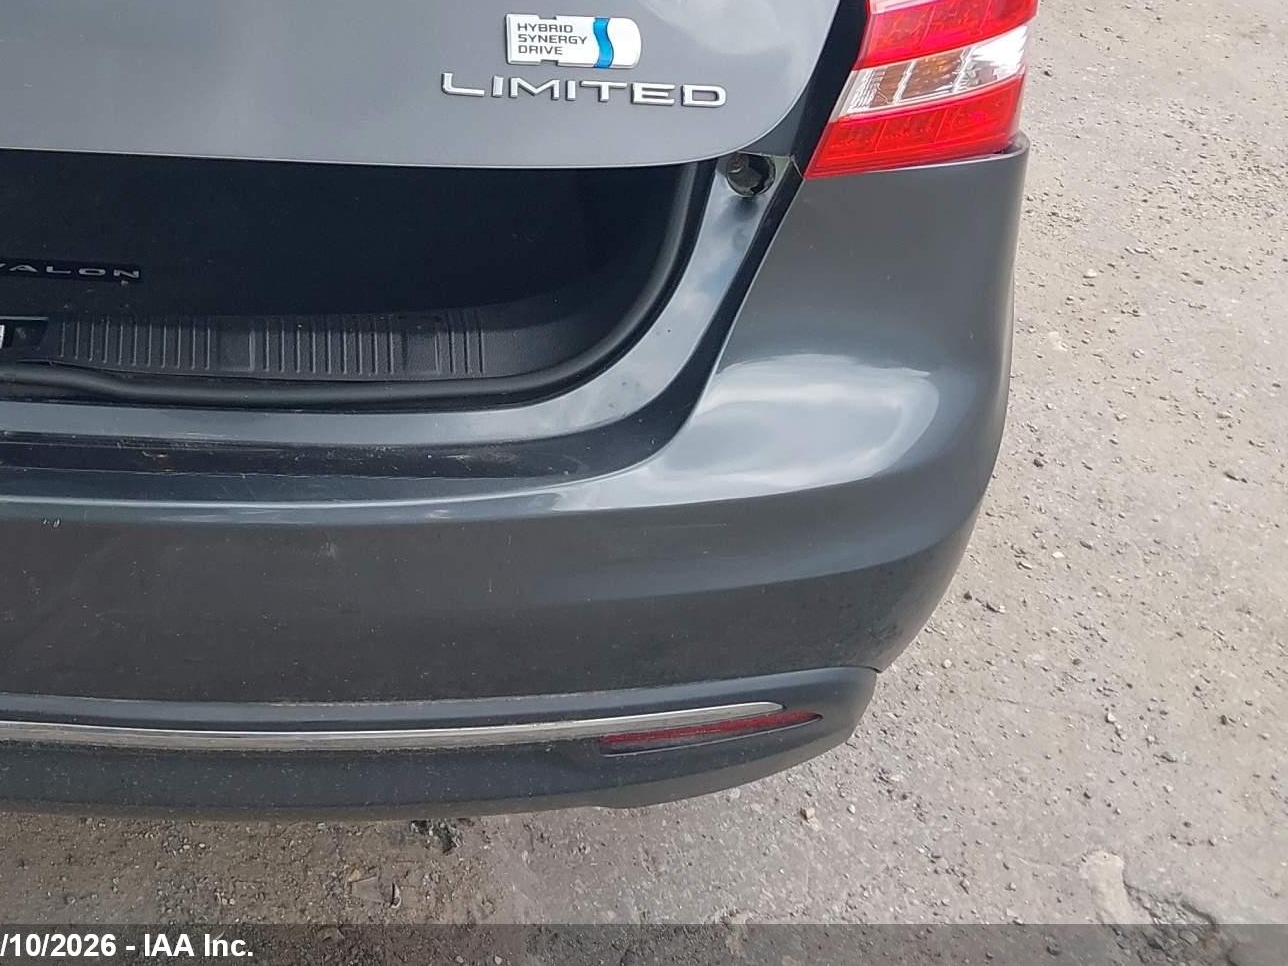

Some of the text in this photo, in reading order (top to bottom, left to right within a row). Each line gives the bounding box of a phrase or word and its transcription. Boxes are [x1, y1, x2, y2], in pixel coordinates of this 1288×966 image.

[517, 22, 574, 34] HYBRID
[517, 33, 588, 45] SYNERGY
[517, 44, 564, 56] DRIVE
[441, 71, 728, 109] LIMITED
